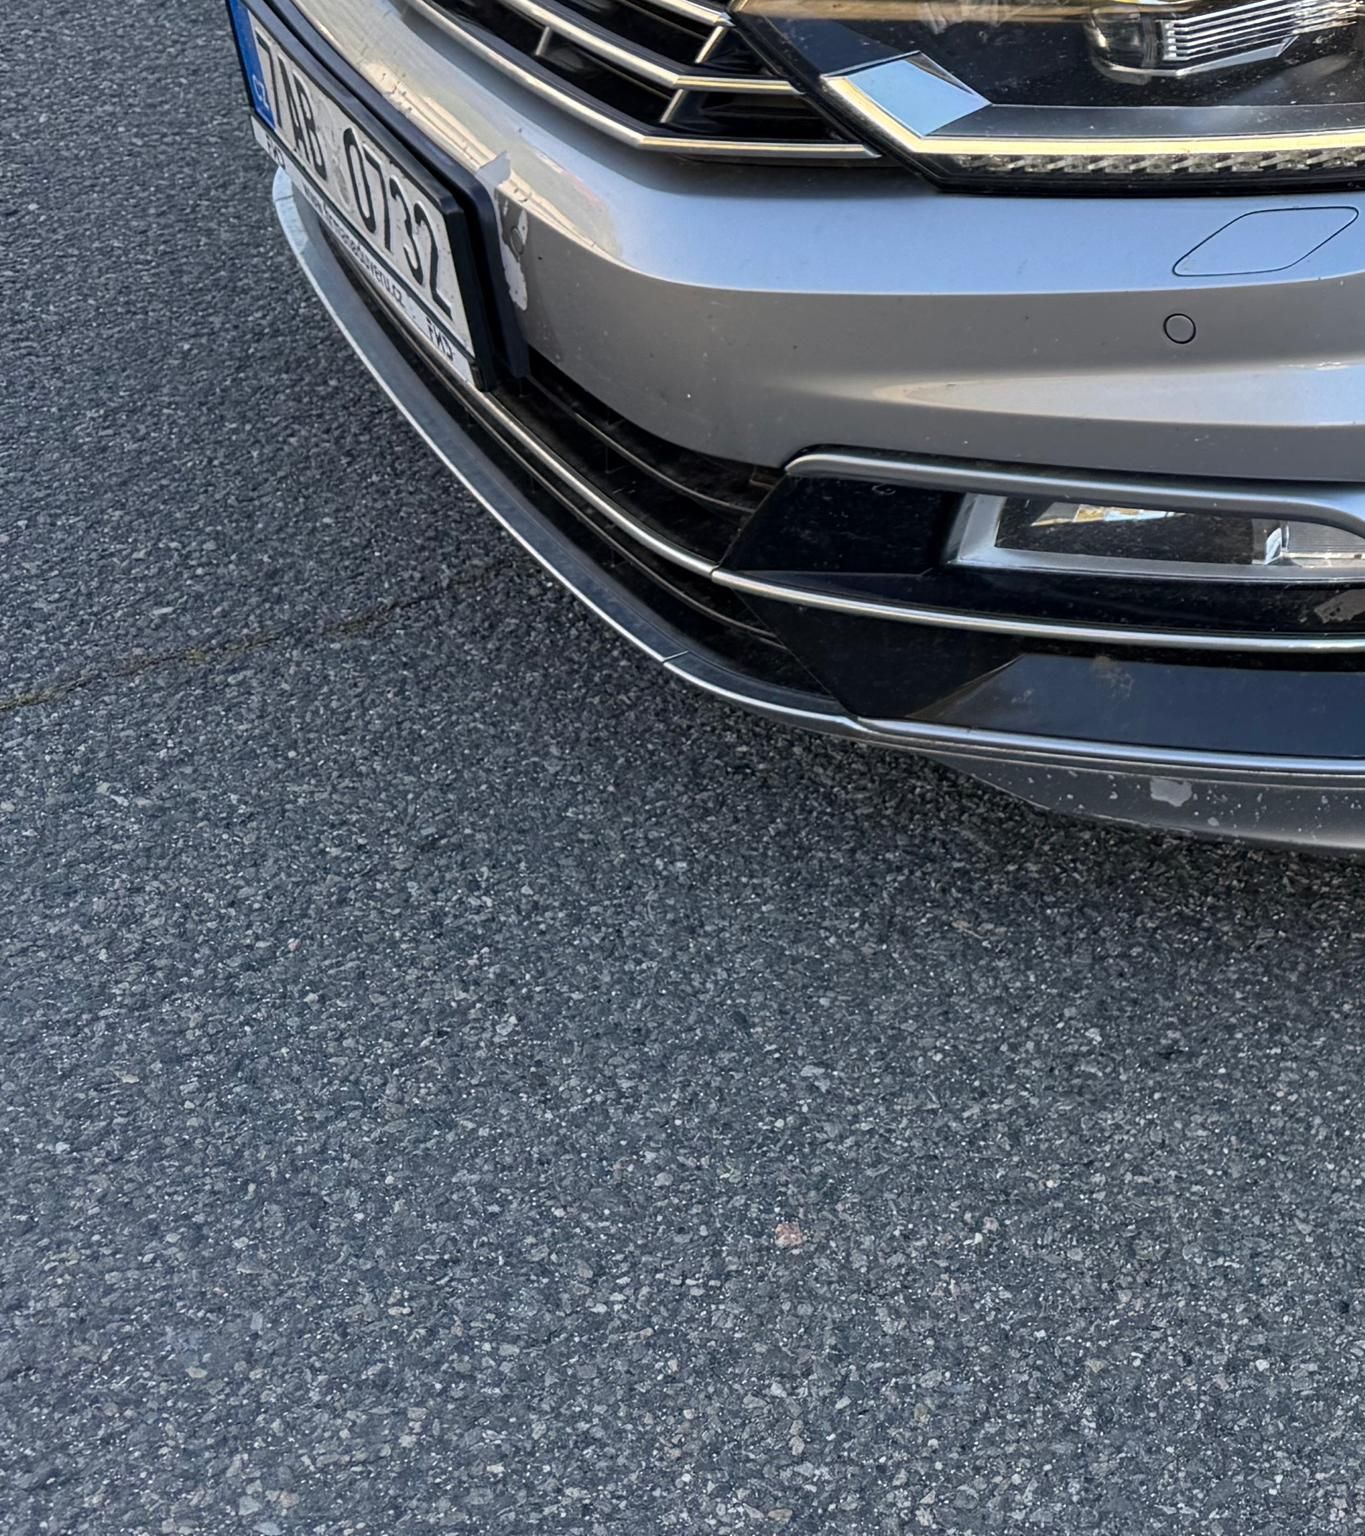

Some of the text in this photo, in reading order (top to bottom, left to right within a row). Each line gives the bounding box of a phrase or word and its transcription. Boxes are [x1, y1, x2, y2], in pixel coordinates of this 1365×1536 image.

[252, 74, 270, 114] CZ
[254, 26, 328, 181] 7AB
[342, 125, 452, 321] 0732
